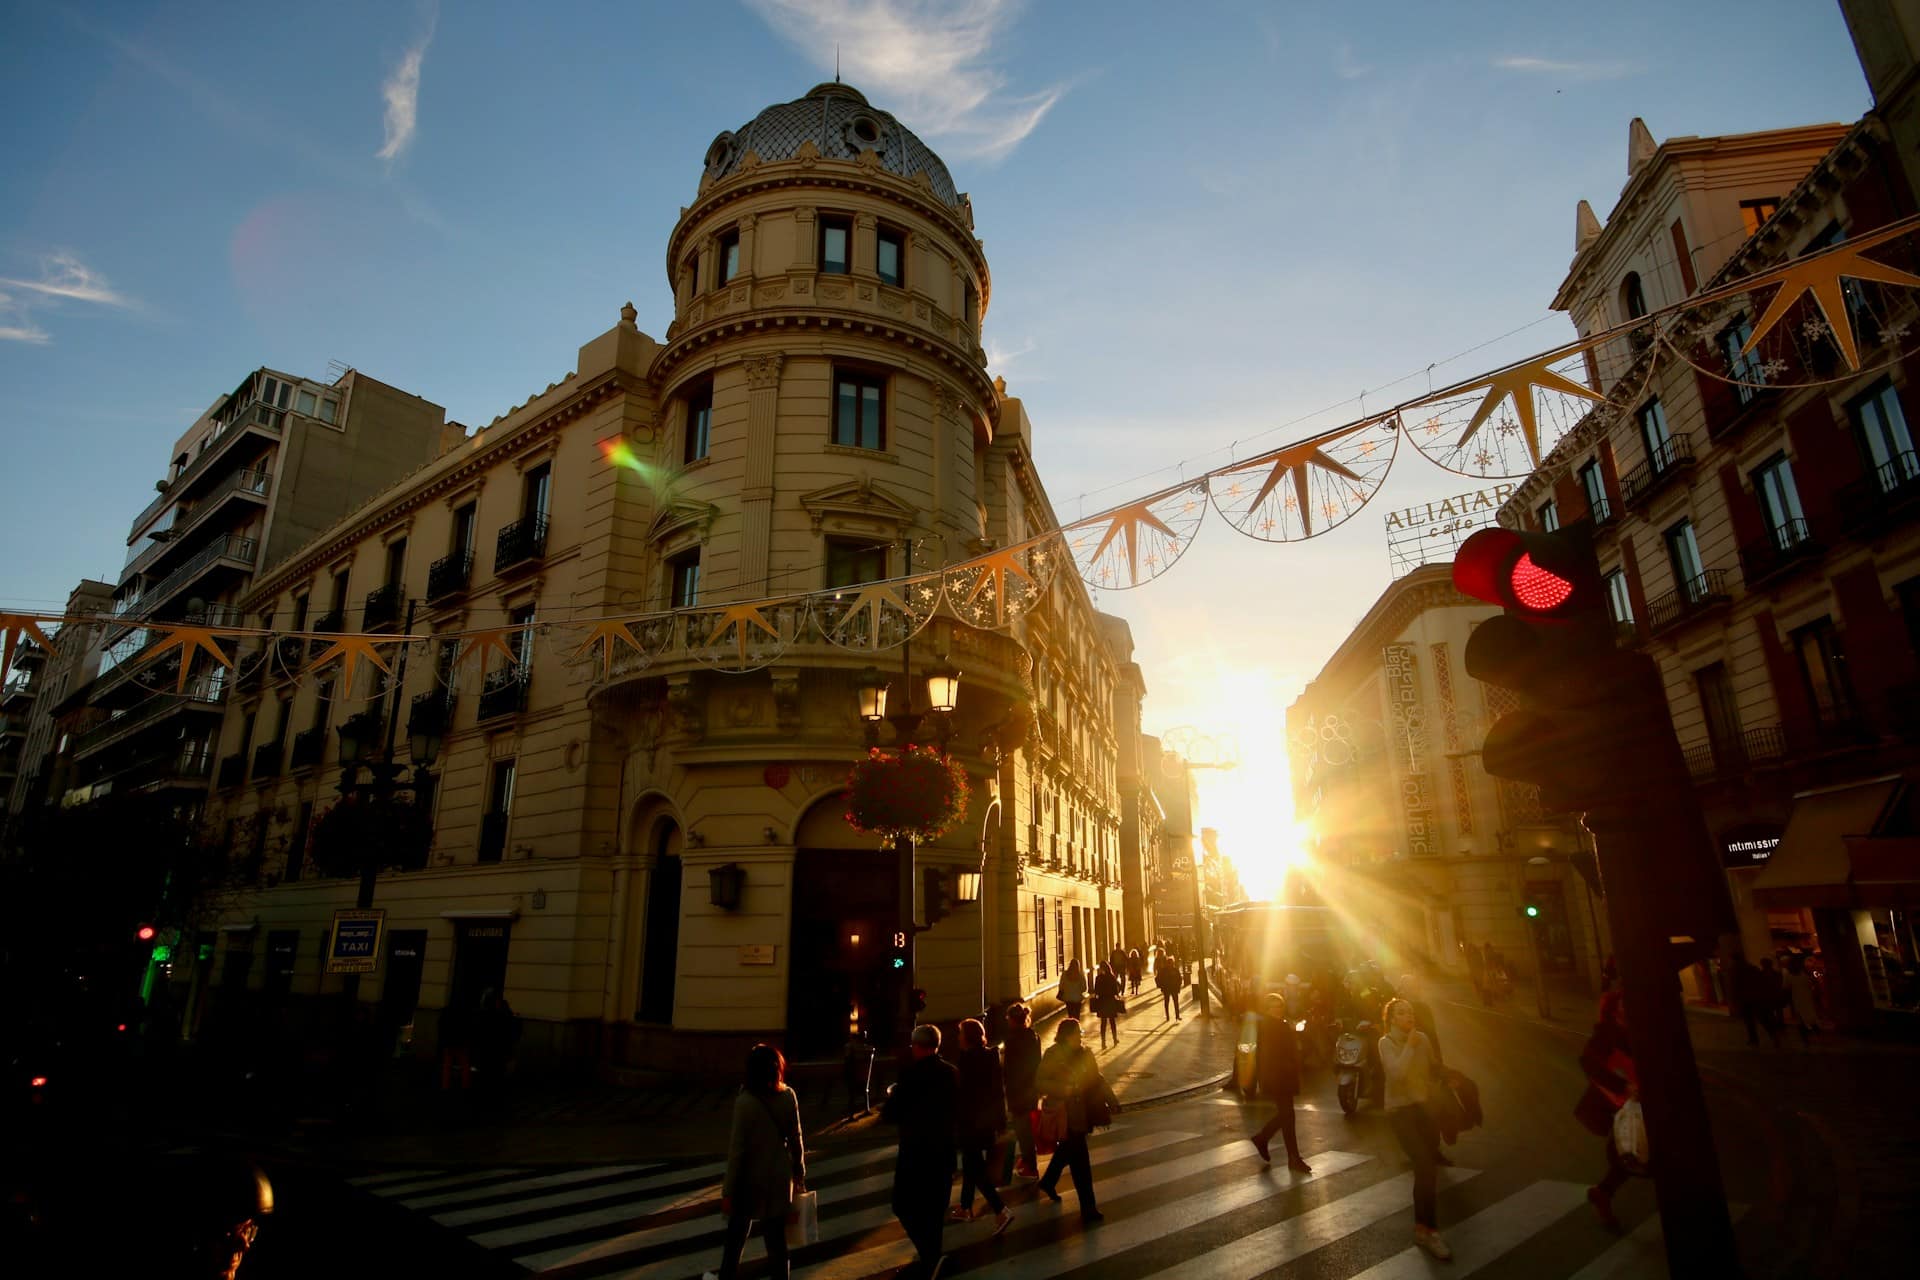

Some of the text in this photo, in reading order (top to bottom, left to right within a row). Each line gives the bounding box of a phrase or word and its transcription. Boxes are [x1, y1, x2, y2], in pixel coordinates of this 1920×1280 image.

[1387, 483, 1513, 528] ALIATAR
[341, 942, 369, 952] TAXI
[894, 932, 905, 948] 13
